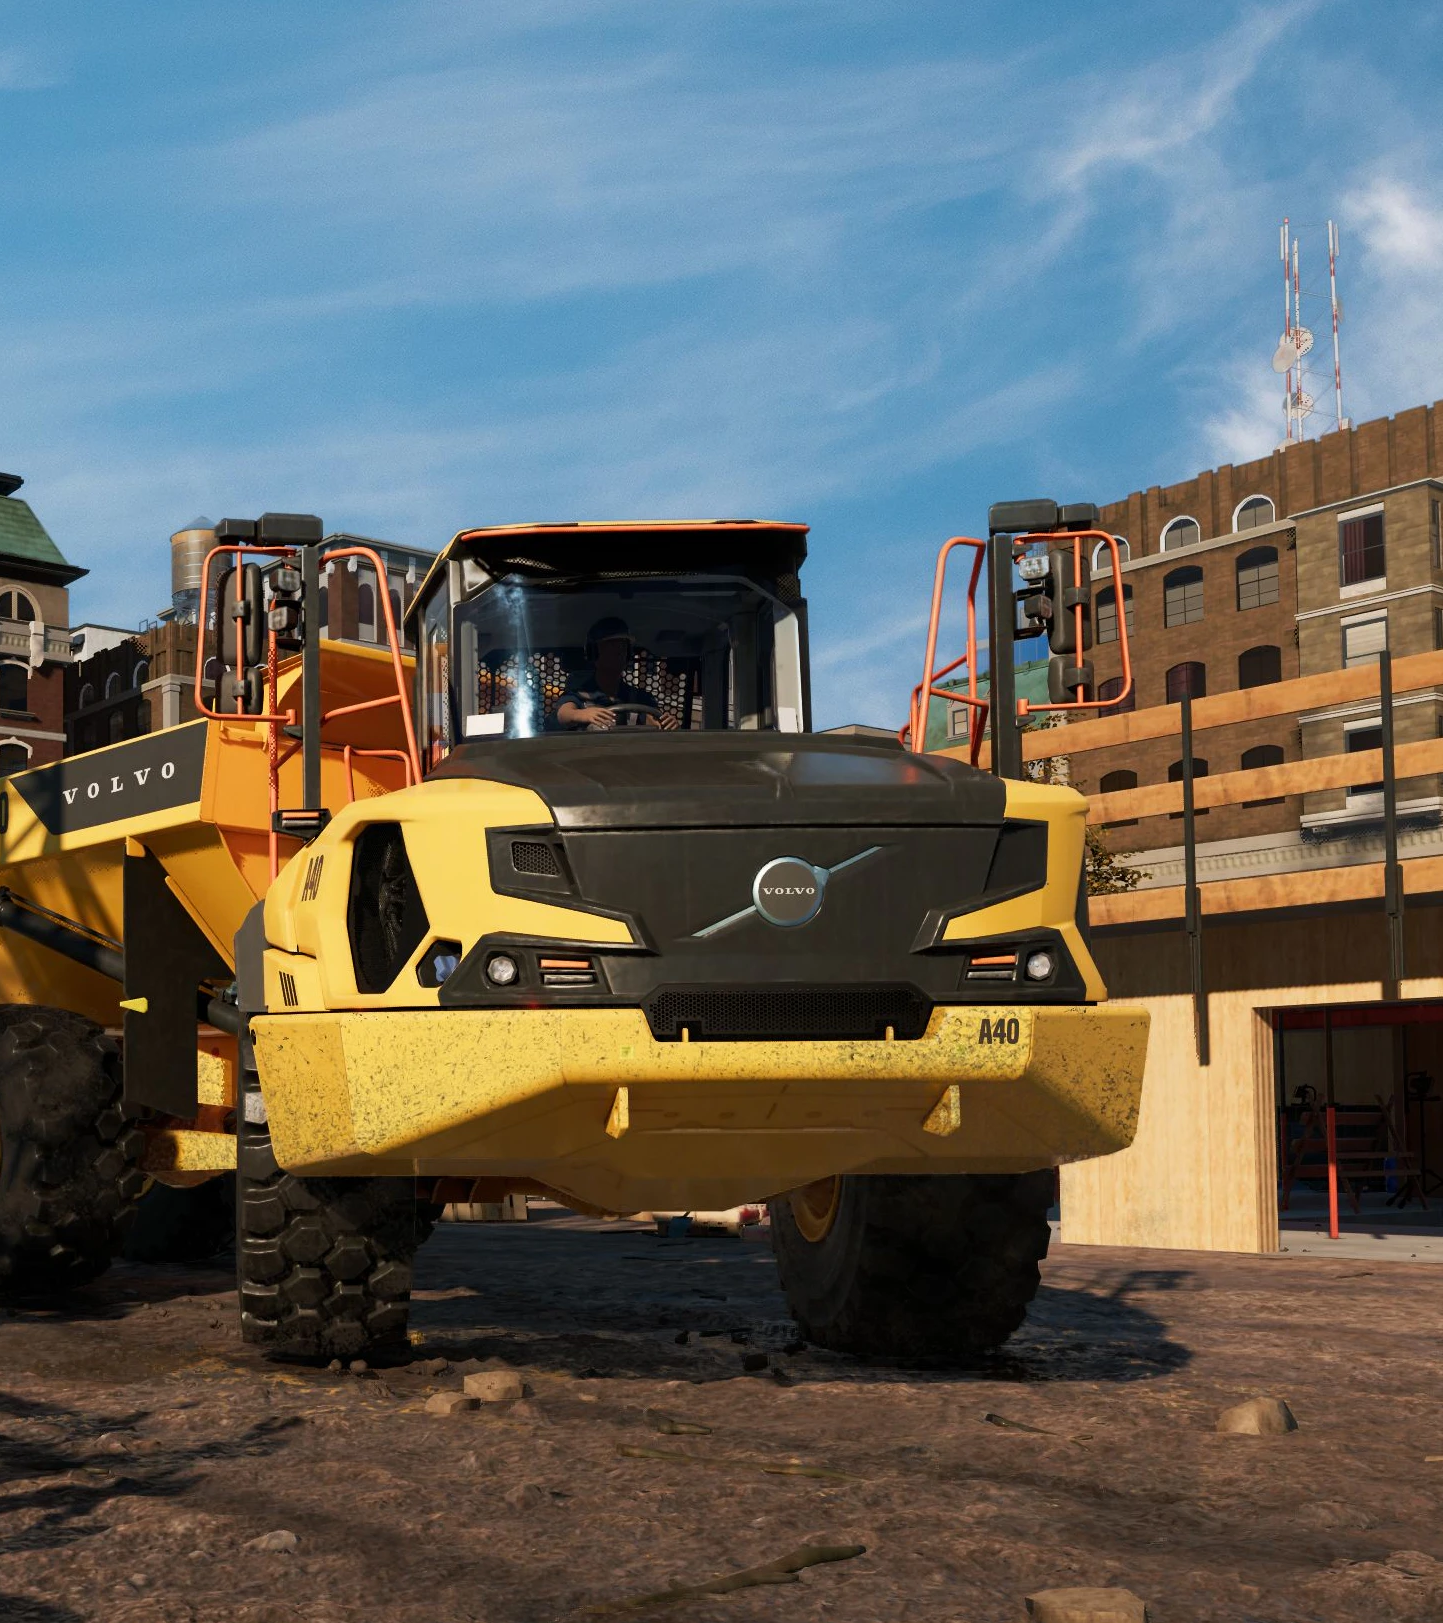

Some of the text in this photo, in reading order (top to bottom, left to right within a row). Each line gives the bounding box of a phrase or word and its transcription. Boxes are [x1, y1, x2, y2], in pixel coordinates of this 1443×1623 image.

[62, 761, 176, 805] VOLVO
[301, 854, 324, 902] A40
[762, 887, 816, 895] VOLVO
[978, 1018, 1020, 1045] A40
